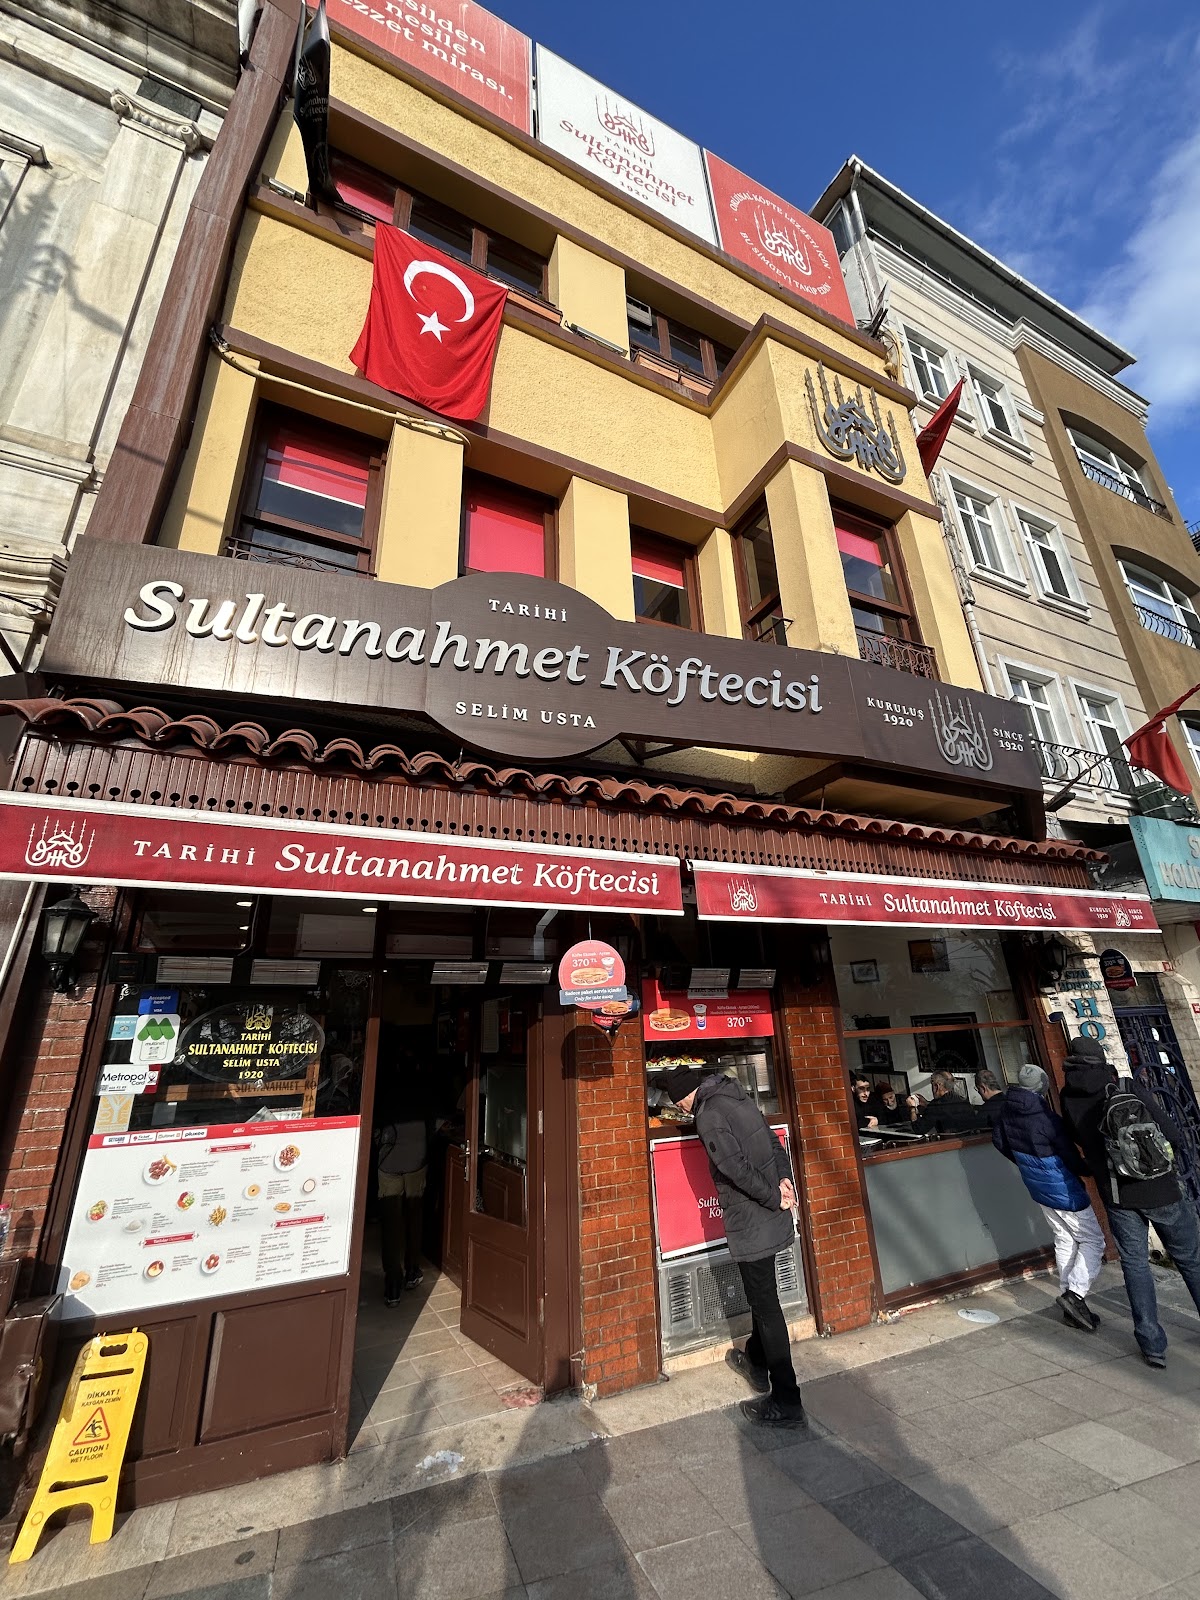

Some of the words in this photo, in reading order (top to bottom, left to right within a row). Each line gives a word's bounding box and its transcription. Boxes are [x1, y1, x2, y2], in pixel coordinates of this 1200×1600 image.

[385, 1, 467, 56] nesile
[401, 0, 486, 54] silden
[422, 41, 513, 100] mirası.
[560, 120, 695, 206] Sultanahmet
[586, 146, 677, 207] Köftecisi
[620, 181, 648, 200] 1920
[740, 231, 754, 246] BU
[489, 598, 567, 622] TARİHİ
[124, 580, 588, 684] Sultanahmet
[600, 646, 821, 713] Köftecisi
[455, 701, 528, 722] SELİM
[540, 710, 596, 729] USTA
[866, 697, 925, 721] KURULUŞ
[883, 713, 914, 728] 1920
[992, 727, 1024, 743] SINCE
[999, 740, 1024, 752] 1920
[133, 840, 255, 866] TARİHİ
[275, 844, 523, 886] Sultanahmet
[533, 863, 660, 896] Köftecisi
[820, 892, 872, 906] TARİHİ
[884, 893, 992, 917] Sultanahmet
[995, 899, 1057, 921] Köftecisi
[572, 958, 590, 968] 370
[726, 1017, 745, 1028] 370
[240, 1031, 272, 1041] TARİHİ
[187, 1043, 265, 1055] SULTANAHMET
[268, 1040, 318, 1054] KÖFTECİSİ
[223, 1057, 251, 1068] SELİM
[256, 1058, 280, 1067] USTA
[100, 1072, 148, 1083] Metropol
[238, 1070, 264, 1080] 1920
[87, 1390, 116, 1400] DİKKAT
[68, 1445, 104, 1457] CAUTION
[70, 1455, 84, 1463] WET
[83, 1453, 103, 1461] FLOOR
